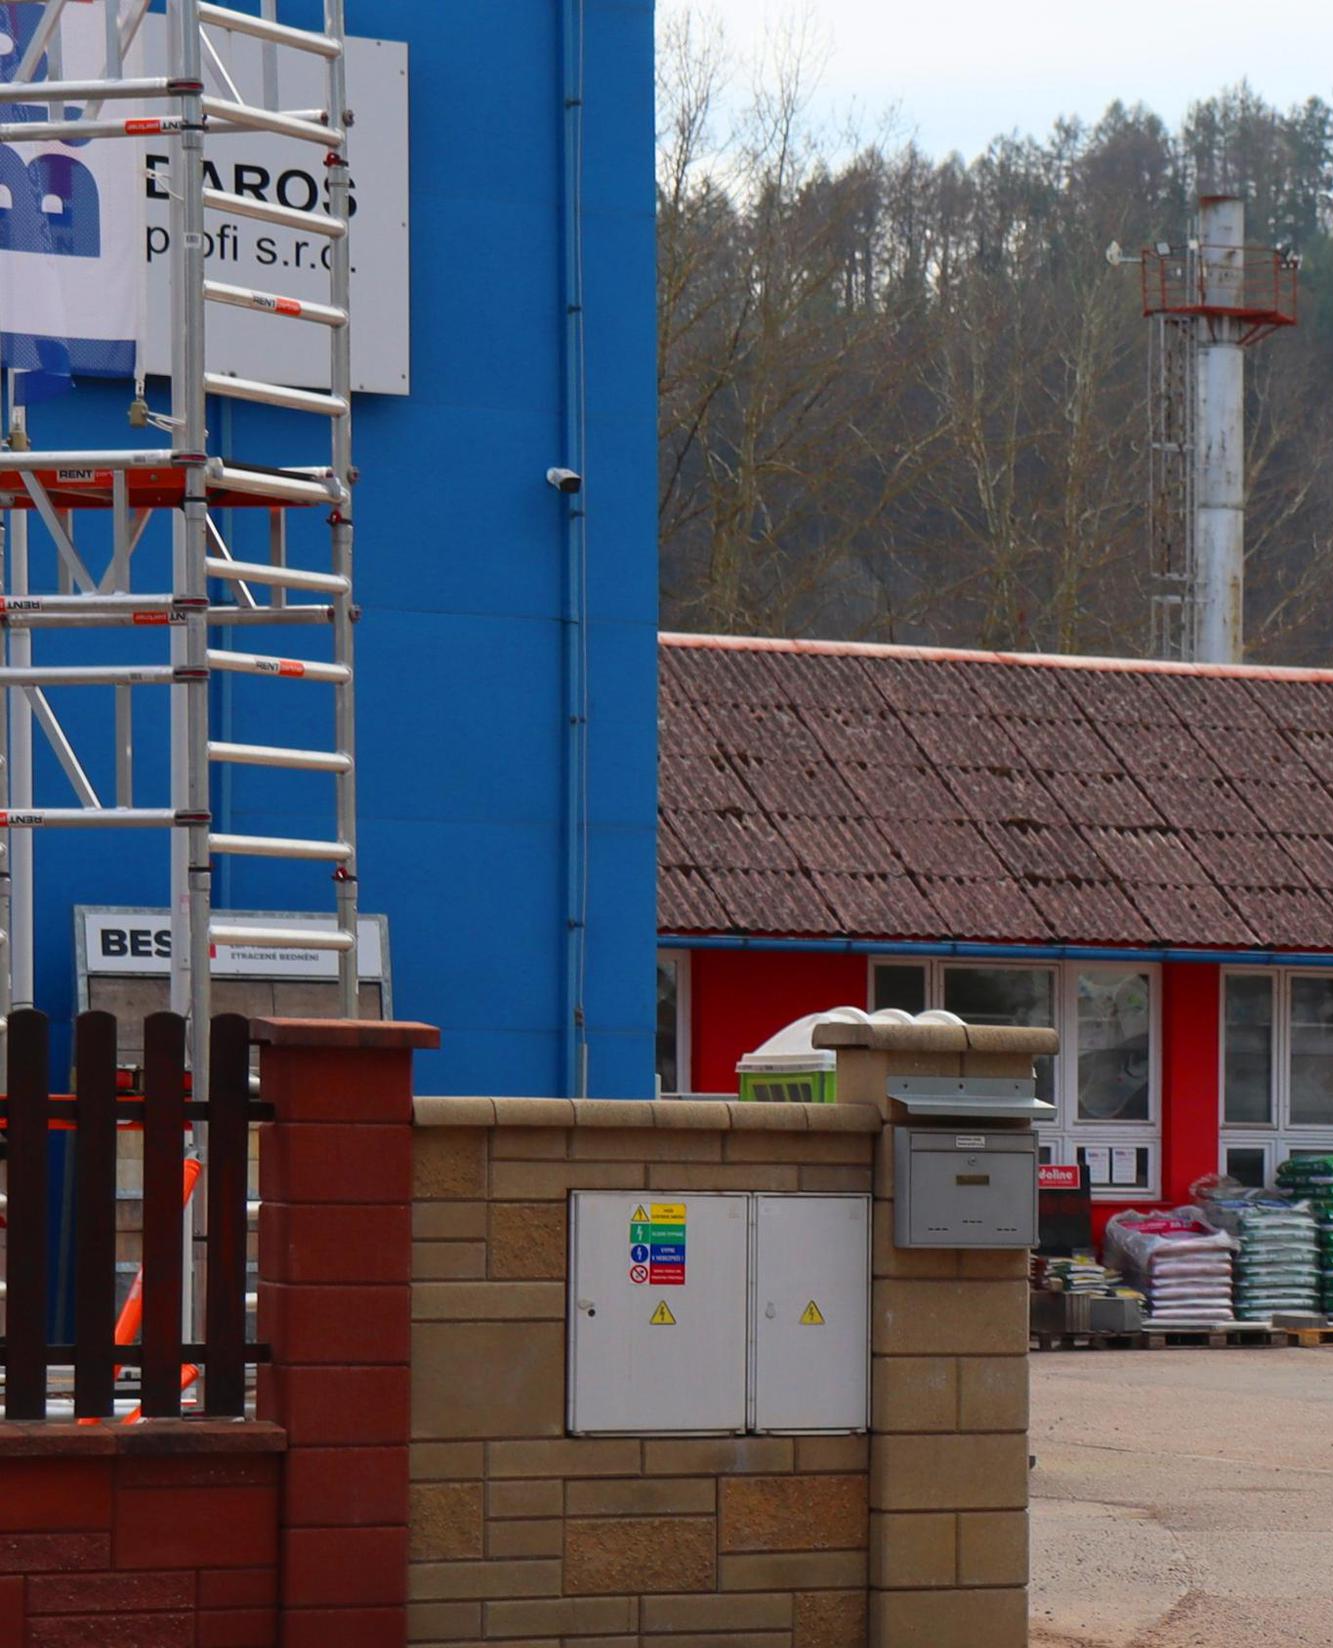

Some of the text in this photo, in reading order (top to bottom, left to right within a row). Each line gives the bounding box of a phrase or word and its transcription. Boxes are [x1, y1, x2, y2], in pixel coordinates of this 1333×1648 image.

[60, 469, 93, 478] RENT
[7, 601, 40, 610] RENT
[9, 815, 43, 824] RENT
